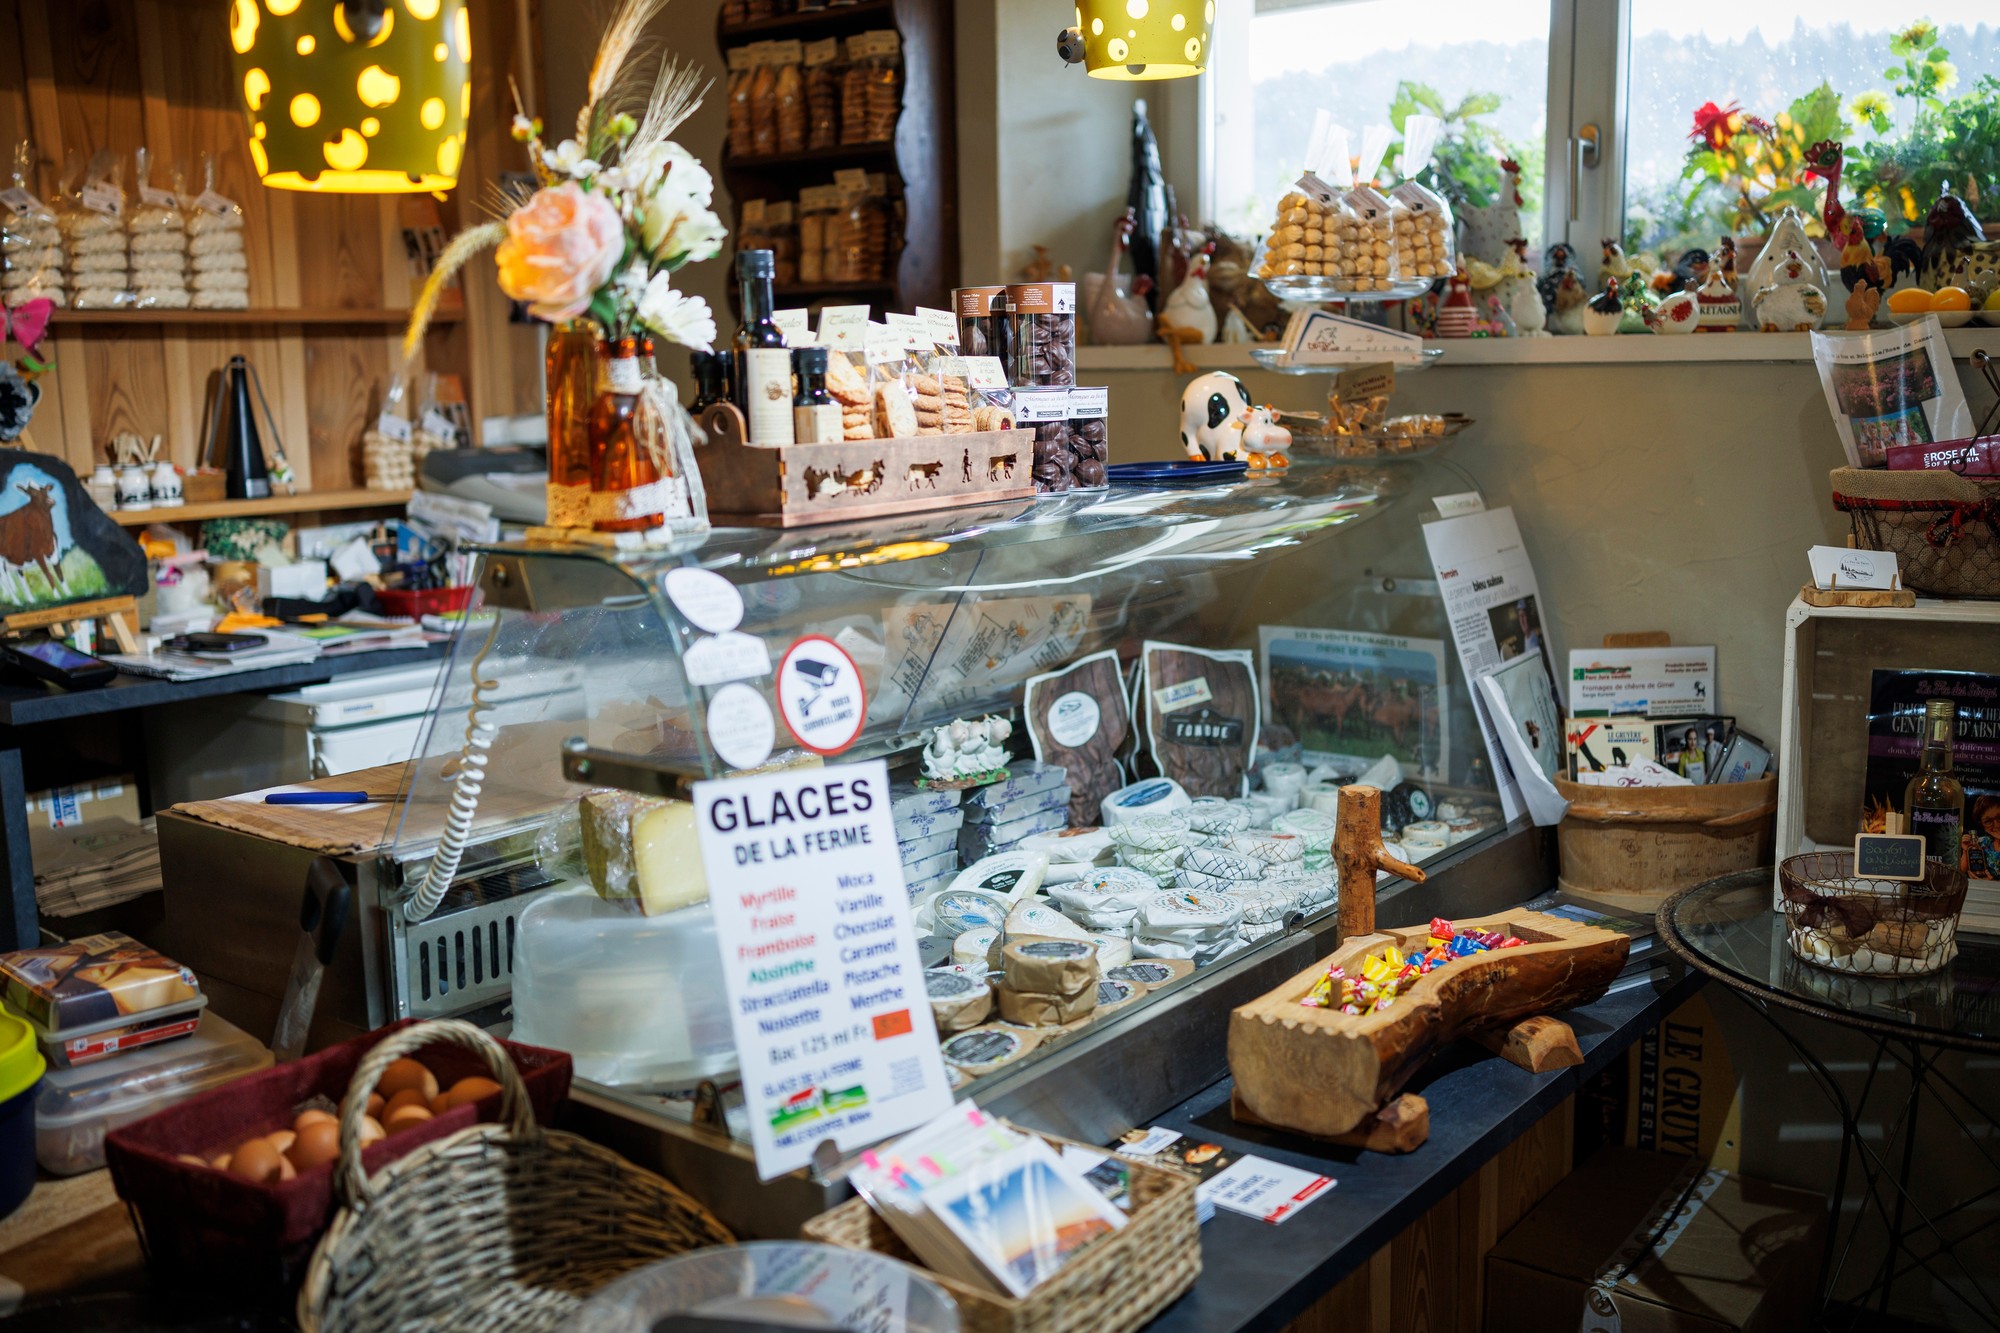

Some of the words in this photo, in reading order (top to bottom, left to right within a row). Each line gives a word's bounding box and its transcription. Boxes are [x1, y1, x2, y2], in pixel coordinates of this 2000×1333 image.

[1700, 305, 1737, 315] RETAGN
[1930, 450, 1958, 461] ROSE
[1961, 447, 1979, 457] OIL
[1943, 457, 1980, 466] BLGRIA
[1440, 569, 1459, 580] Terroirs
[1472, 580, 1487, 592] bleu
[1486, 575, 1504, 588] suisse
[1324, 632, 1350, 642] VENTE
[1352, 635, 1395, 647] FROMAGES
[1397, 639, 1409, 648] DE
[1582, 684, 1613, 693] Fromages
[1624, 681, 1646, 690] chèvre
[1176, 723, 1229, 739] FONDUE
[1892, 717, 1926, 734] GENTI
[1959, 721, 2000, 738] D'ABSIN
[711, 779, 873, 831] GLACES
[734, 841, 763, 865] DE
[770, 837, 797, 859] LA
[804, 824, 872, 854] FERME
[1865, 841, 1907, 857] Savon
[740, 886, 797, 911] Myrtille
[837, 873, 875, 889] Moca
[751, 912, 795, 931] Fraise
[837, 894, 885, 915] Vanille
[738, 934, 816, 960] Framboise
[833, 914, 896, 940] Chocolat
[748, 959, 815, 985] Absinthe
[840, 938, 897, 963] Caramel
[740, 980, 830, 1015] Stracciatella
[844, 963, 902, 987] Pistache
[758, 1008, 822, 1036] Noisette
[850, 986, 904, 1012] Menthe
[769, 1044, 796, 1066] Bac
[802, 1035, 829, 1056] 125
[833, 1030, 849, 1046] ml
[1665, 1020, 1703, 1062] LE
[1641, 1027, 1656, 1142] SWITZERL
[1661, 1066, 1702, 1158] GRUY
